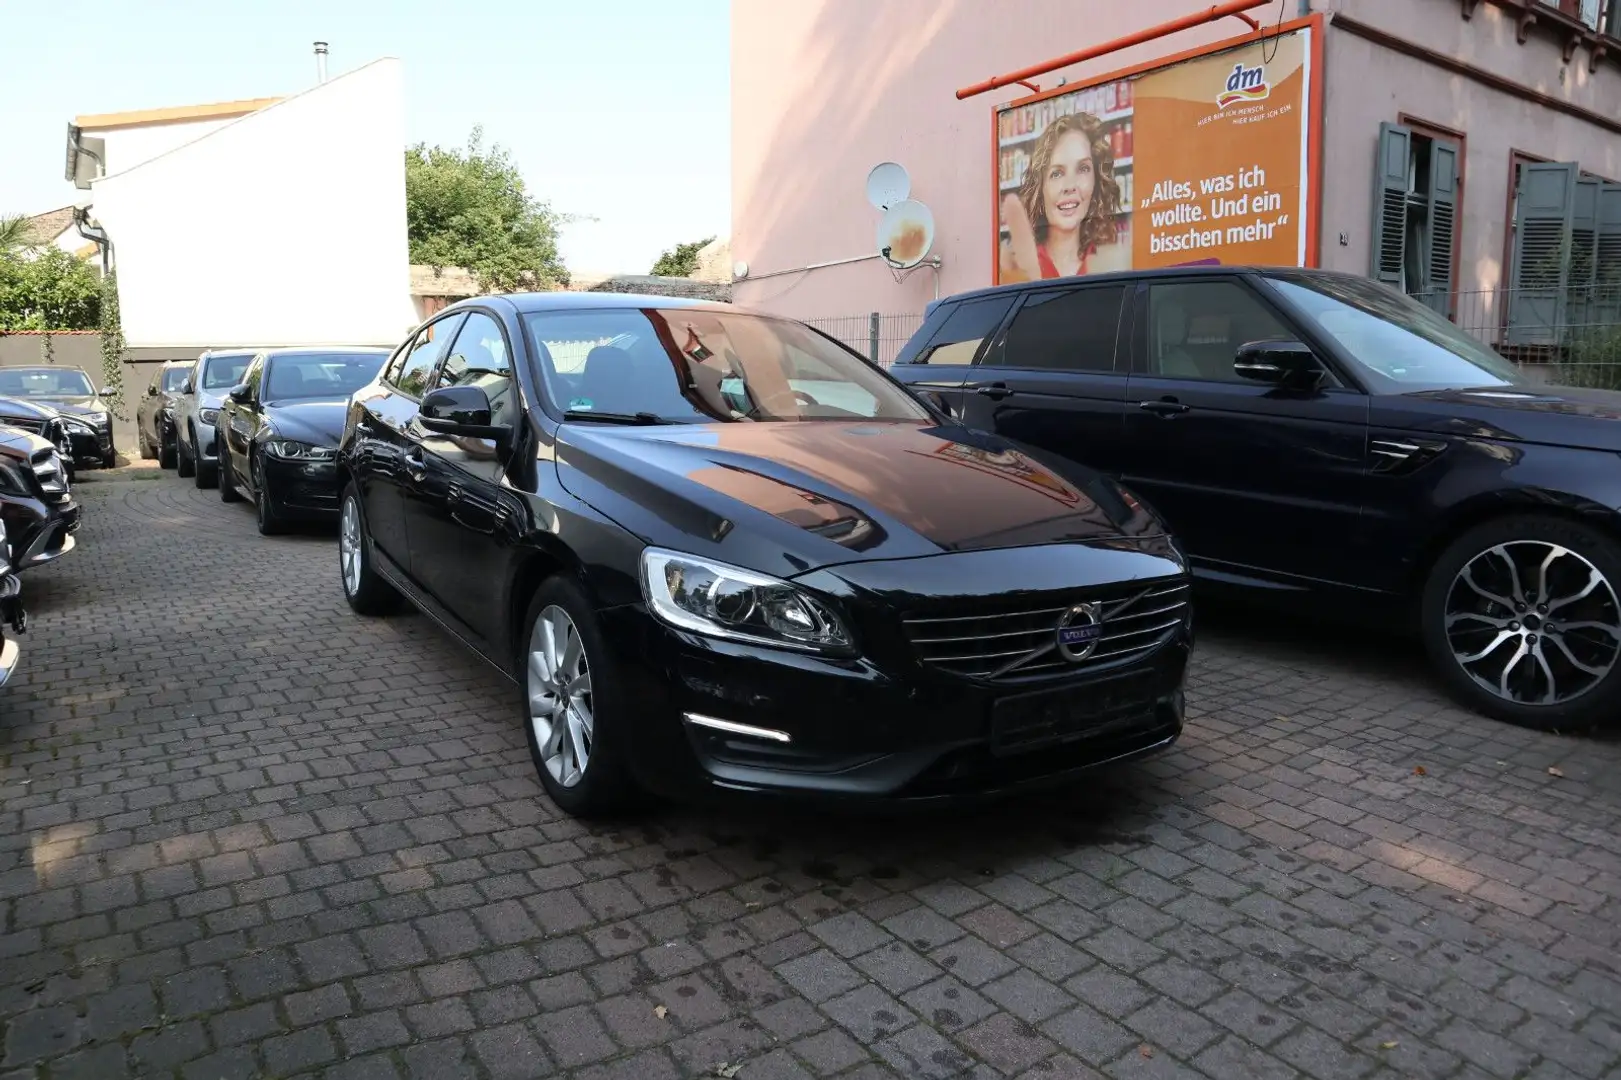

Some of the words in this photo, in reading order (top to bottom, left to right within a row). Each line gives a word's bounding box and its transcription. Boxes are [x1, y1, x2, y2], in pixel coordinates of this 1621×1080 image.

[1227, 64, 1263, 91] dm
[1213, 111, 1225, 120] BIN
[1238, 104, 1264, 115] MENSCH
[1140, 179, 1196, 209] „Alles,
[1199, 174, 1234, 195] was
[1238, 164, 1265, 189] ich
[1151, 203, 1207, 228] wollte.
[1211, 194, 1248, 219] Und
[1252, 190, 1281, 213] ein
[1150, 227, 1222, 254] bisschen
[1226, 214, 1289, 245] mehr“
